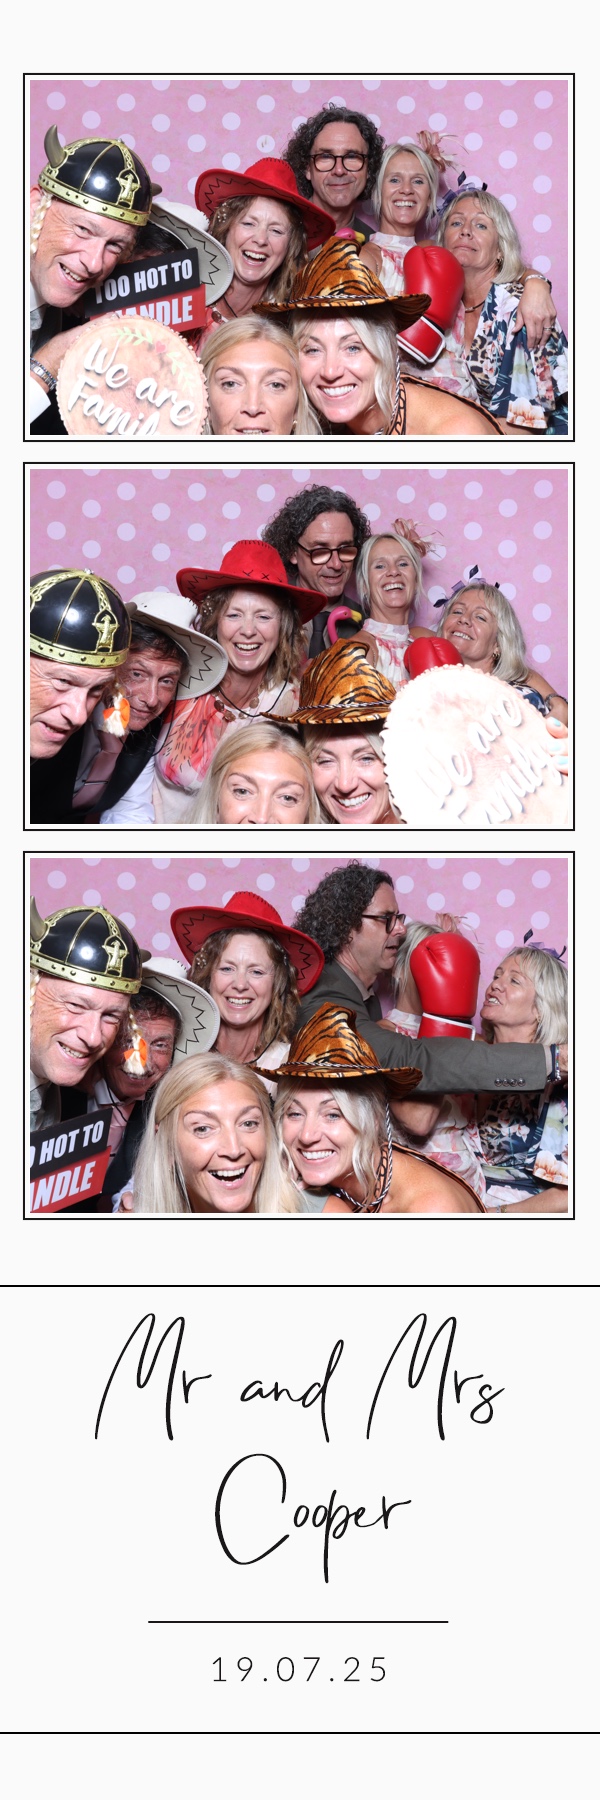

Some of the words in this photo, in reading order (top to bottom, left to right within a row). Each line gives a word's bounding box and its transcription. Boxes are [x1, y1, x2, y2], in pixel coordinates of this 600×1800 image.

[94, 275, 130, 304] TOO
[133, 265, 168, 293] HOT
[171, 259, 193, 282] TO
[67, 373, 160, 434] Famil
[83, 337, 132, 390] We
[135, 377, 198, 427] are
[467, 694, 522, 755] are
[39, 1128, 80, 1165] HOT
[82, 1120, 104, 1147] TO
